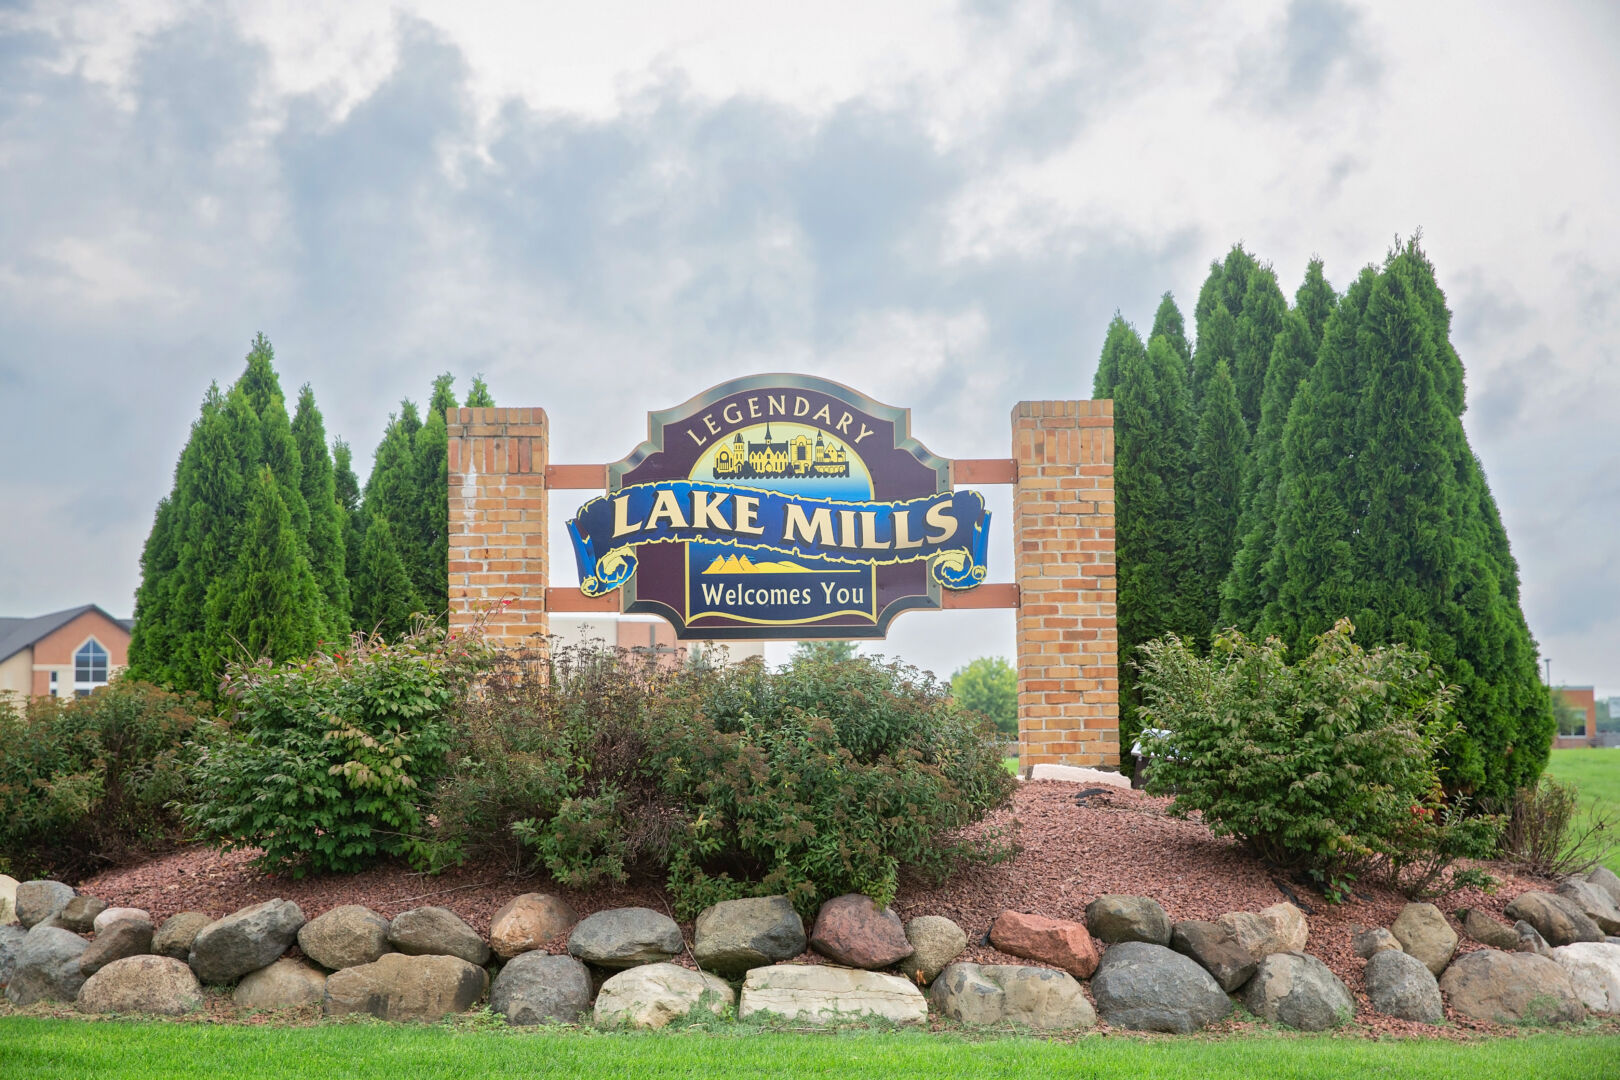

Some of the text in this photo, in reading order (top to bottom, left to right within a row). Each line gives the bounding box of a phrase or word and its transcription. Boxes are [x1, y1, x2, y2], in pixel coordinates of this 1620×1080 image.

[687, 395, 874, 446] LEGENDARY
[612, 489, 958, 549] LAKE MILLS
[701, 582, 865, 606] Welcomes You
